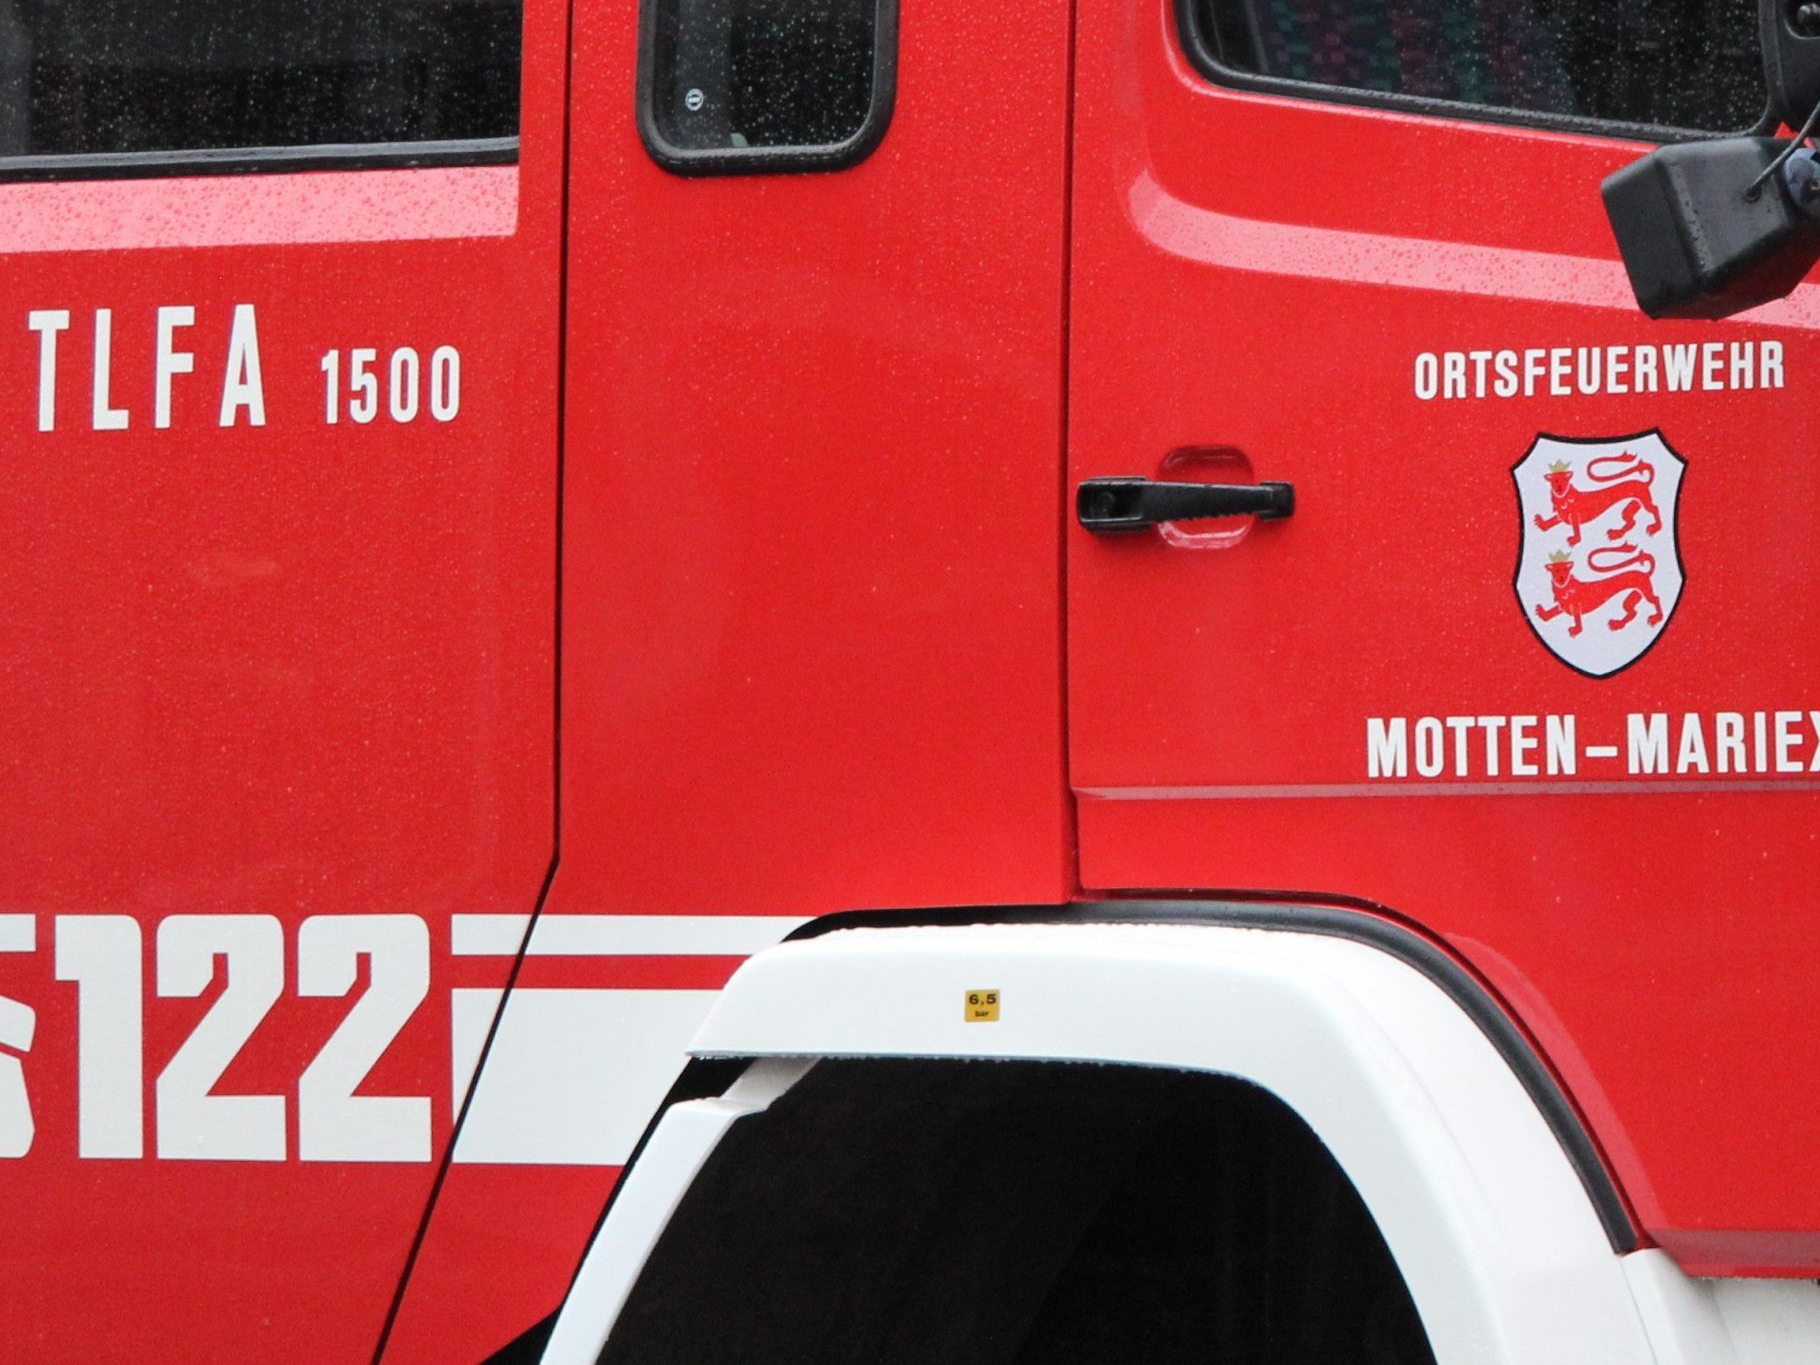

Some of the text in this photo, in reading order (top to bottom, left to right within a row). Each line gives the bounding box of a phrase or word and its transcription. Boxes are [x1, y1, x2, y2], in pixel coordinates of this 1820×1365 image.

[28, 303, 461, 432] TLFA 1500
[1414, 340, 1785, 400] ORTSFEUERWEHR
